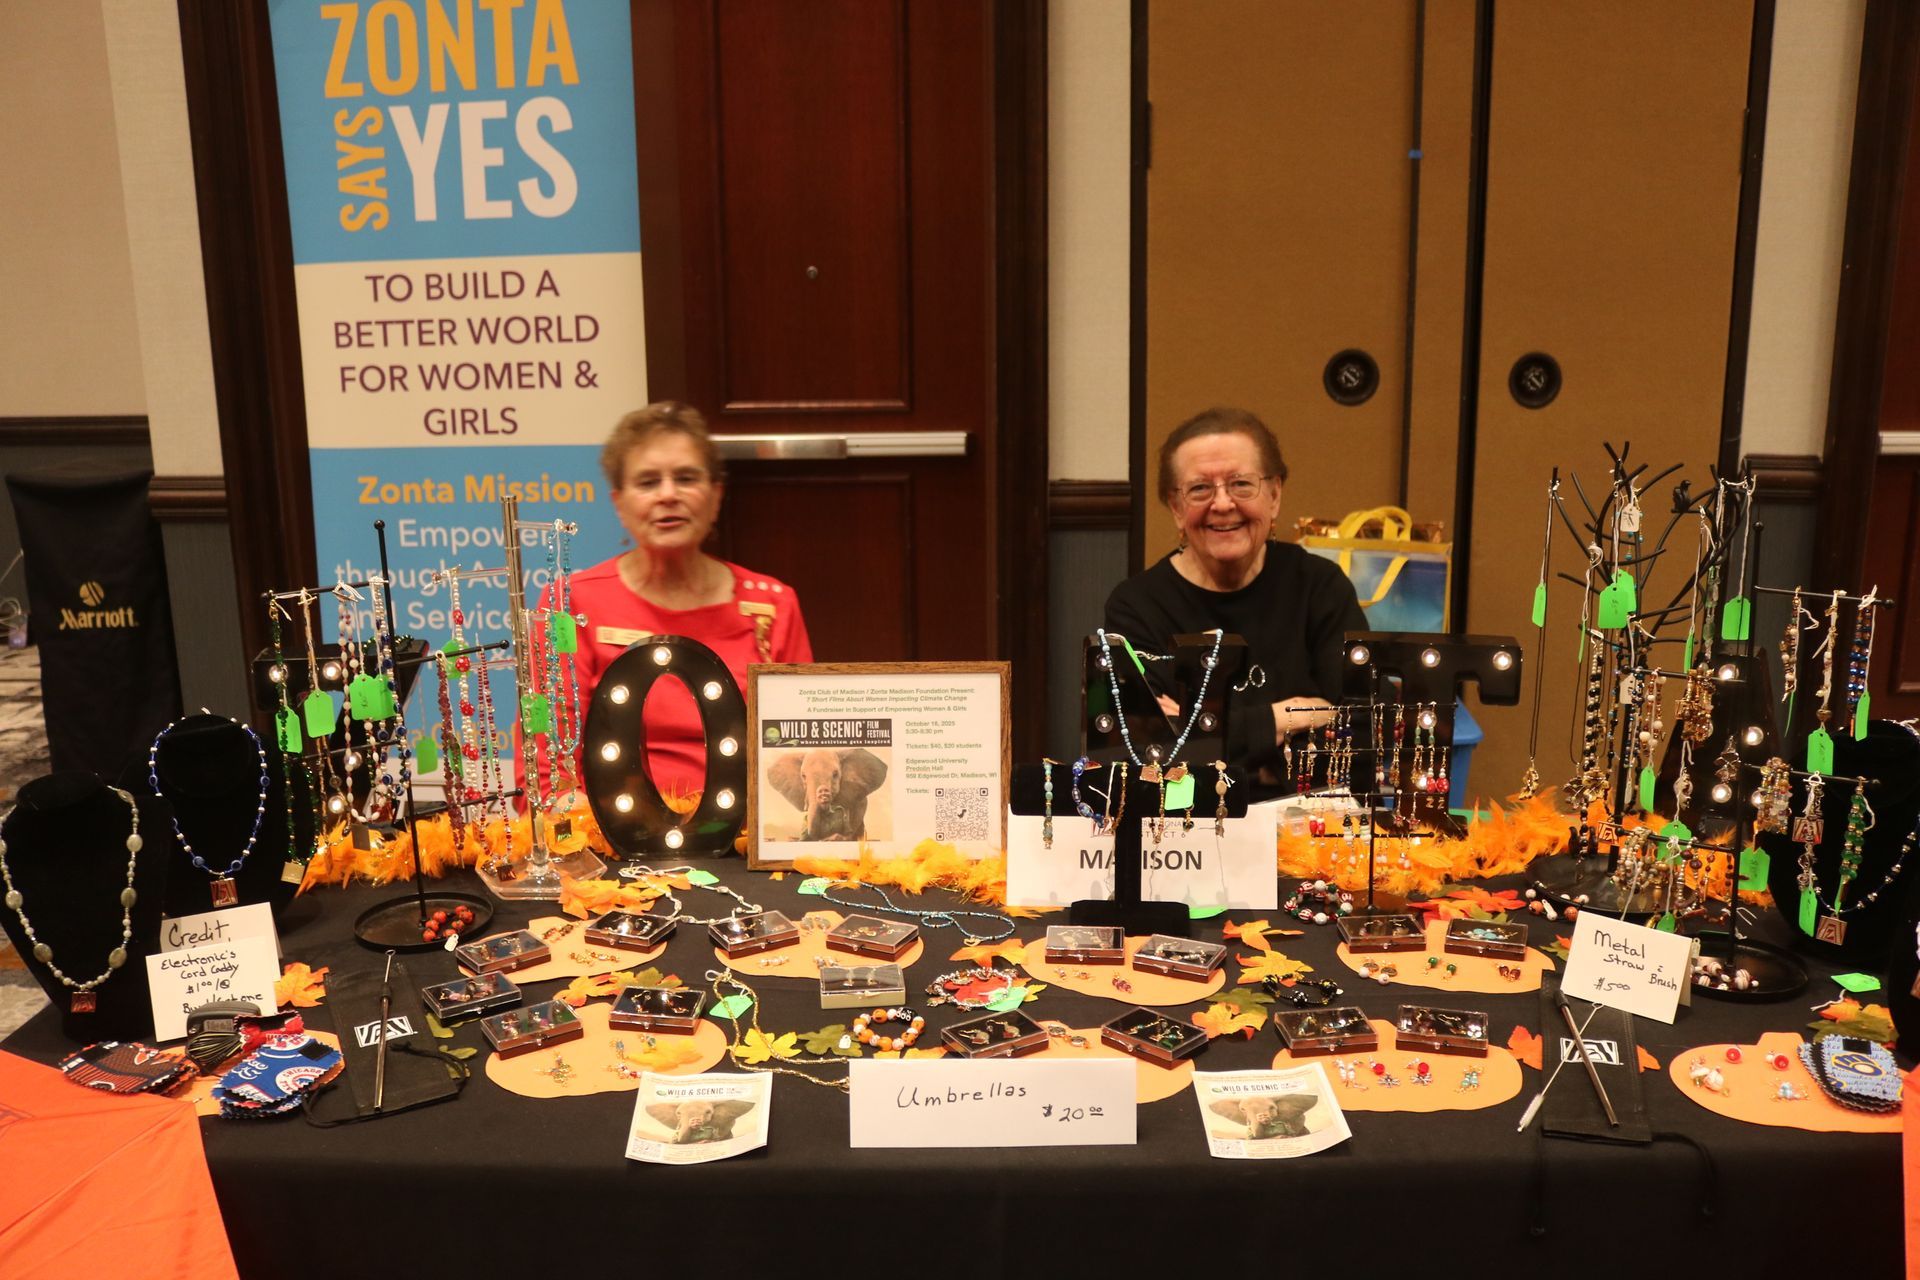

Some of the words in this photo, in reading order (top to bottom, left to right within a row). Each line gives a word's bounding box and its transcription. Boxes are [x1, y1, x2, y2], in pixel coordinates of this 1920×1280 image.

[320, 0, 580, 98] ZONTA
[333, 106, 390, 232] SAYS
[387, 96, 578, 222] YES
[365, 274, 413, 302] TO
[425, 270, 525, 301] BUILD
[535, 269, 560, 298] A
[333, 318, 458, 349] BETTER
[466, 314, 600, 345] WORLD
[339, 365, 409, 393] FOR
[418, 361, 563, 391] WOMEN
[574, 360, 599, 389] &
[423, 407, 519, 436] GIRLS
[357, 476, 455, 504] Zonta
[464, 473, 595, 503] Mission
[59, 606, 136, 630] Marriott
[407, 601, 513, 631] Sevice
[852, 706, 876, 714] Support
[885, 706, 922, 714] Empowering
[888, 695, 919, 703] Impacting
[780, 720, 808, 739] WILD
[810, 720, 820, 739] &
[822, 720, 863, 739] SCENIC
[866, 720, 880, 729] FILM
[866, 729, 891, 739] FESTIVAL
[917, 772, 949, 780] Edgewood
[1079, 849, 1203, 871] MAISON
[168, 919, 230, 948] Credit
[1594, 929, 1646, 959] Metal
[180, 966, 208, 980] Cord
[210, 962, 240, 979] Caddy
[1648, 973, 1678, 991] Brush
[667, 1088, 687, 1097] WILD
[696, 1087, 724, 1096] SCENIC
[896, 1081, 1028, 1109] Umbrellas
[1222, 1084, 1242, 1093] WILD
[1250, 1083, 1279, 1092] SCENIC
